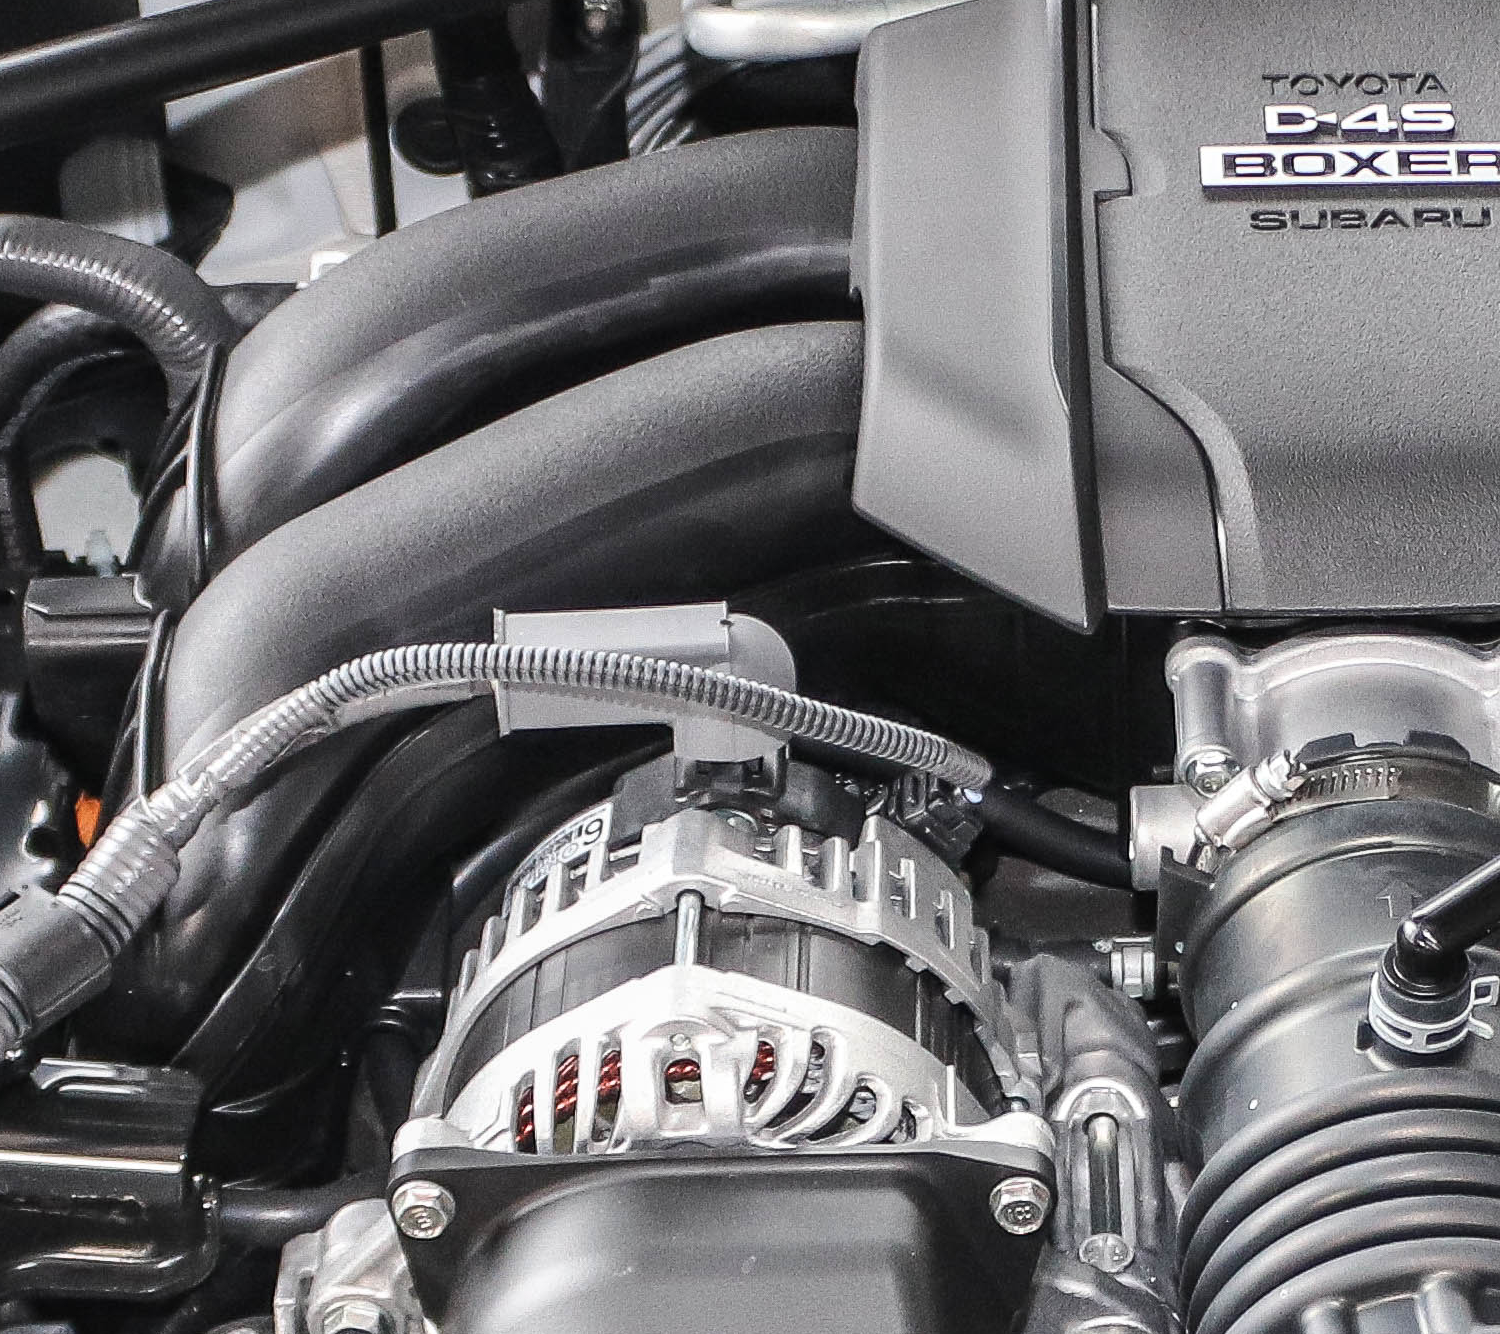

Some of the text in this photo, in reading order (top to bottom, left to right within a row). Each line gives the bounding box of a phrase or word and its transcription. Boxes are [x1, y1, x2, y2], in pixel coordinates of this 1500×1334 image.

[1261, 72, 1448, 96] TOYOTA
[1263, 102, 1456, 136] D-4S
[1249, 205, 1492, 231] SUBARU
